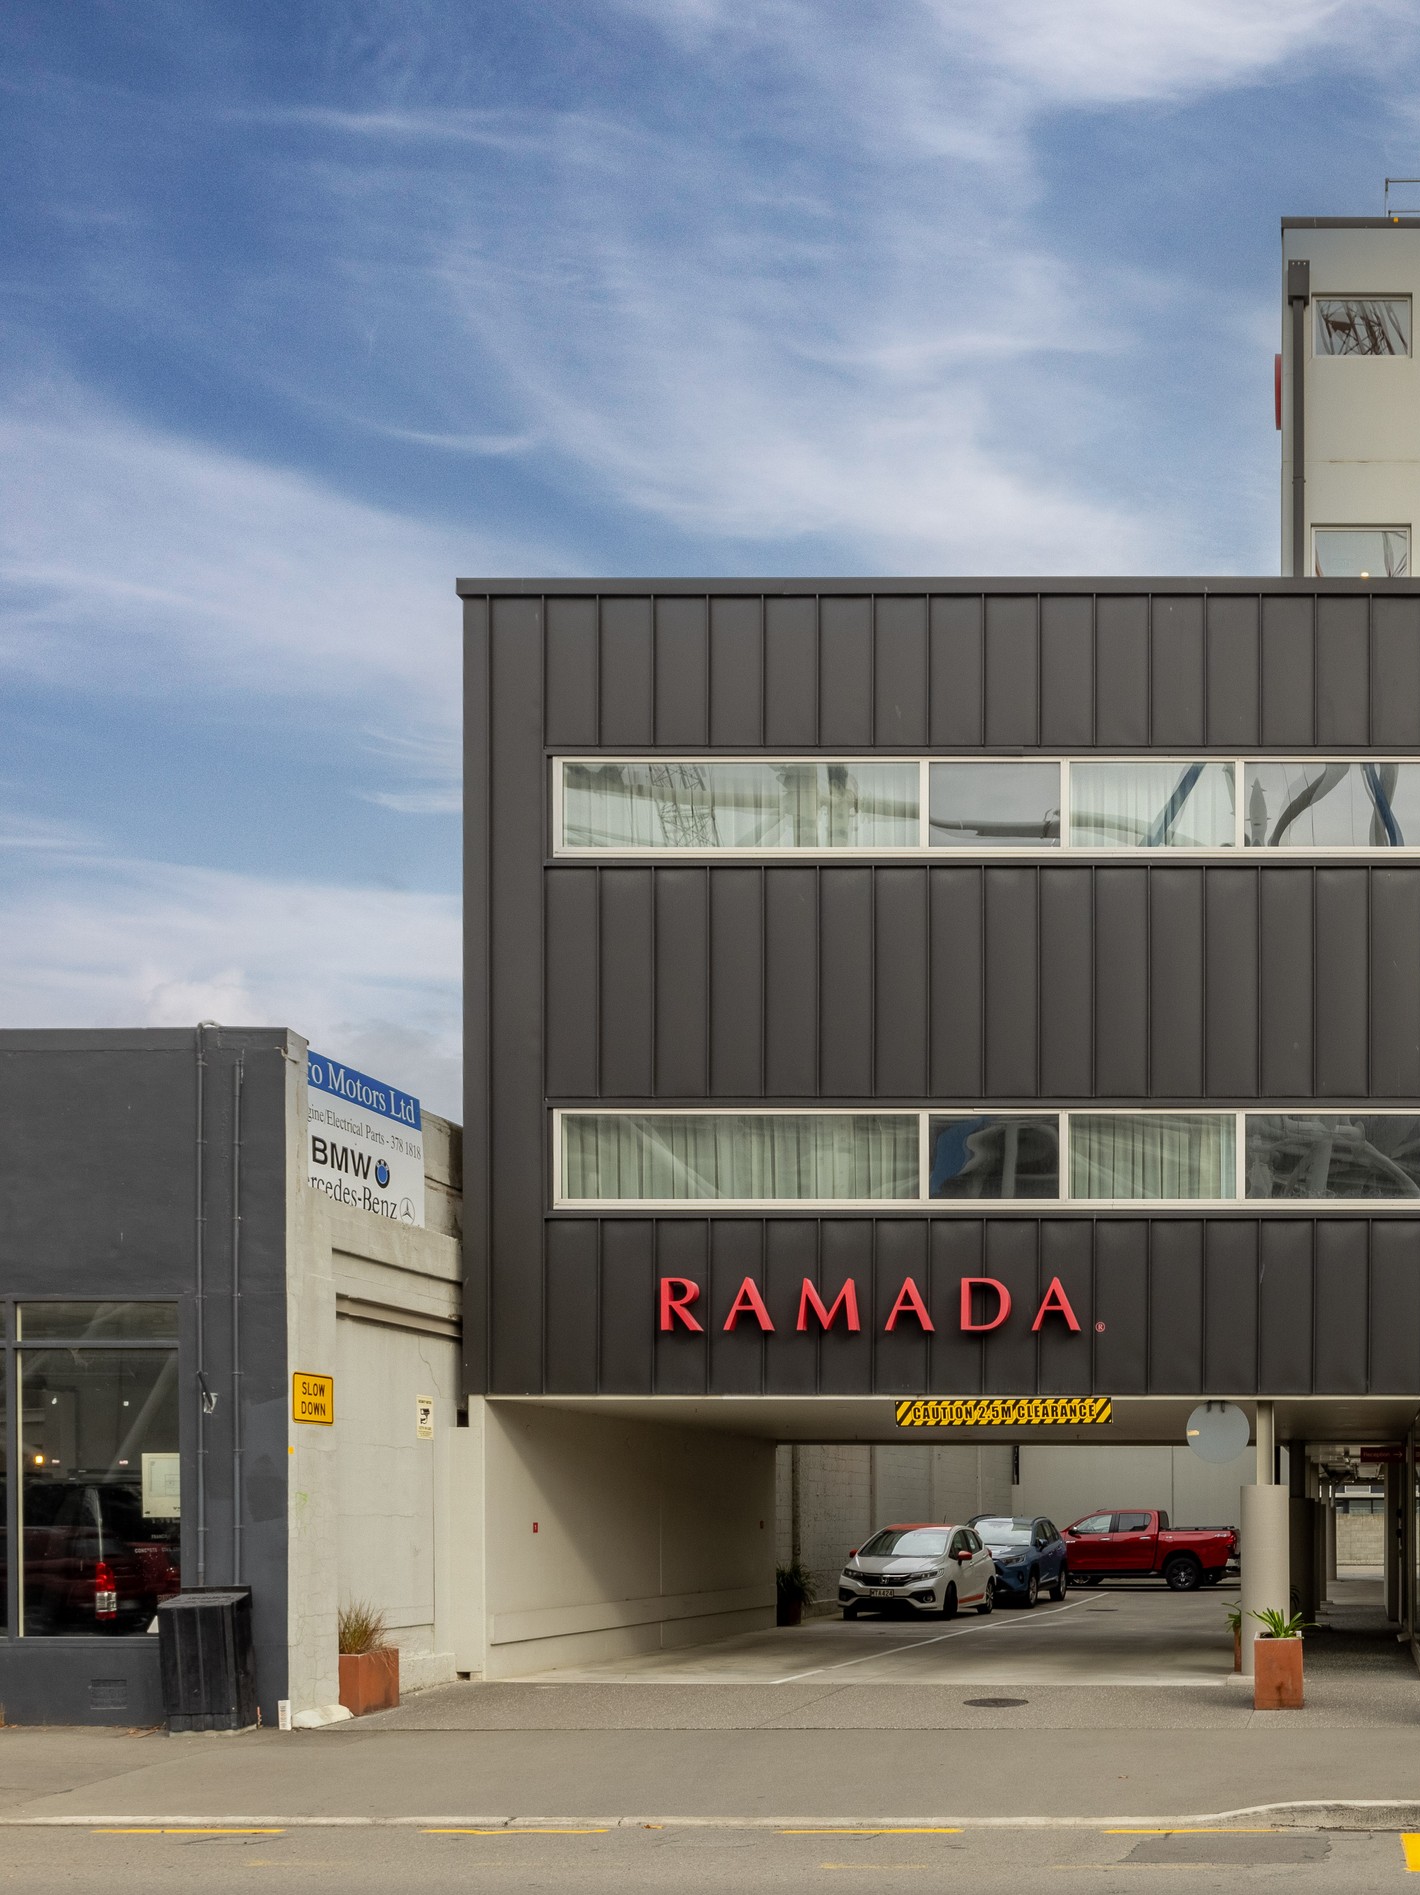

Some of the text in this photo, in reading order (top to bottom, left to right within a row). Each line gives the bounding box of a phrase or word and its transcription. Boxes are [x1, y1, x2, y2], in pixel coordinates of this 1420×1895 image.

[328, 1062, 387, 1112] Motors
[389, 1090, 416, 1124] Ltd
[311, 1135, 372, 1180] BMW
[366, 1124, 385, 1145] Parts
[391, 1135, 404, 1153] 378
[405, 1141, 422, 1160] 1818
[307, 1175, 398, 1220] rcedes-Benz
[660, 1276, 1082, 1332] RAMADA
[301, 1381, 326, 1397] SLOW
[301, 1401, 326, 1416] DOWN
[912, 1404, 1097, 1421] CAUTION 2.5M CLEARANCE
